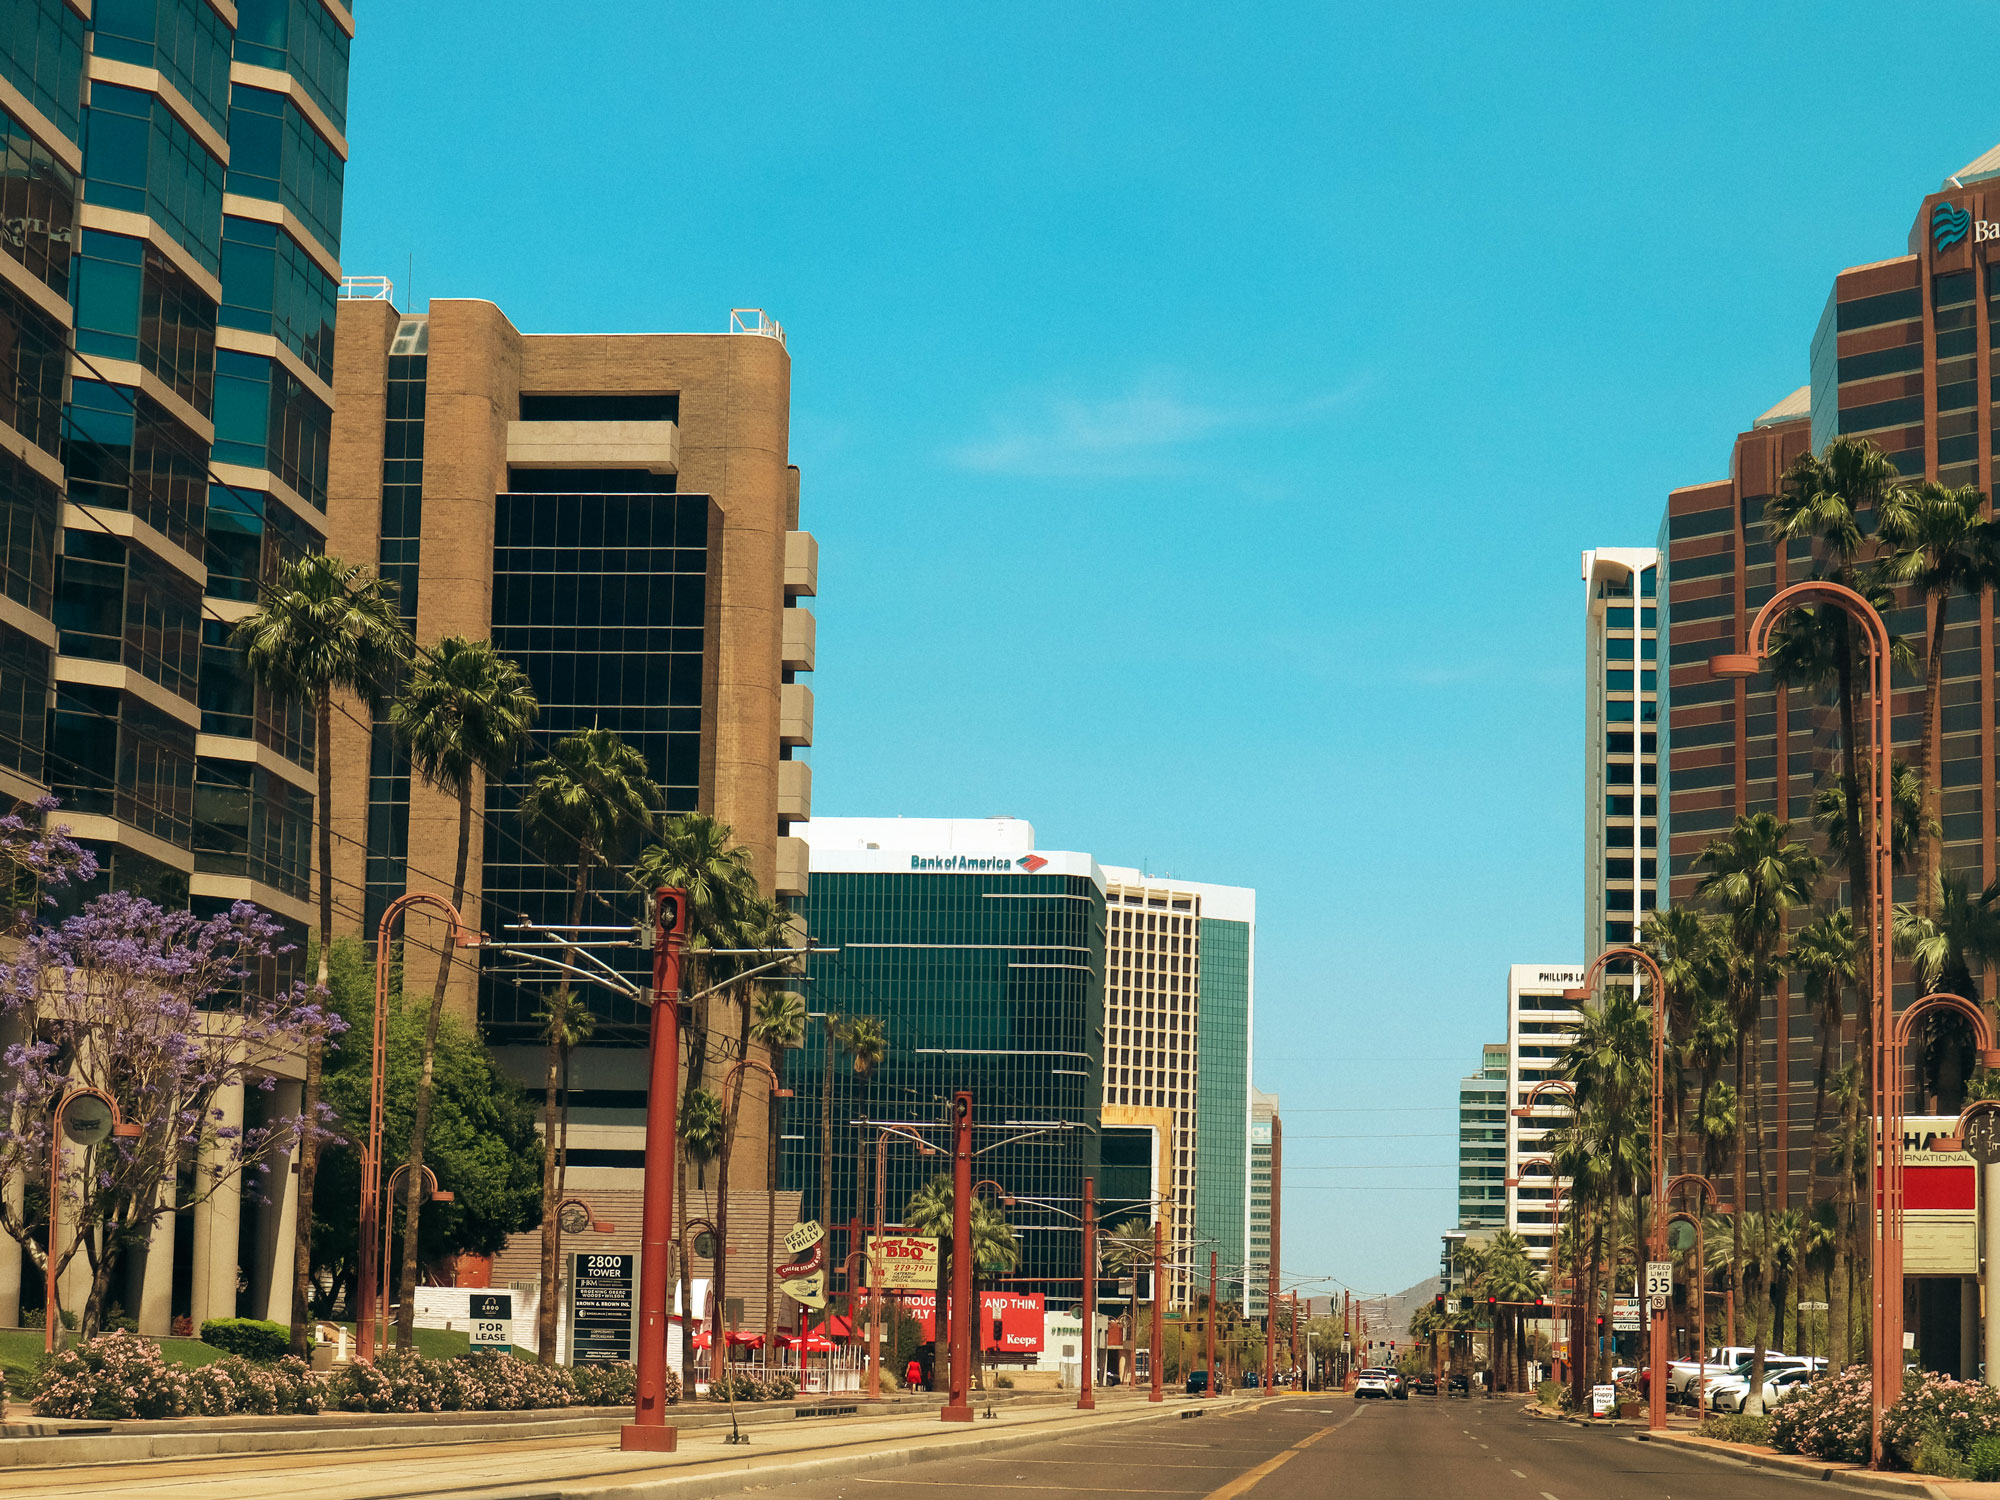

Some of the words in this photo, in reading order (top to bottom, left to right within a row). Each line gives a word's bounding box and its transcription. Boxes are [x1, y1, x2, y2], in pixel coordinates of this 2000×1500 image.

[911, 855, 943, 870] Bank
[944, 854, 957, 870] of
[958, 855, 1011, 871] America
[1539, 973, 1573, 982] PHILLIPS
[785, 1229, 806, 1245] BEST
[807, 1222, 817, 1233] OF
[791, 1230, 819, 1250] PHILLY
[886, 1247, 923, 1261] BBQ
[588, 1255, 622, 1268] 2800
[894, 1264, 933, 1272] 279-7911
[588, 1269, 621, 1277] TOWER
[1648, 1278, 1670, 1292] 35
[984, 1298, 1008, 1308] AND
[1010, 1299, 1040, 1310] THIN.
[478, 1322, 503, 1331] FOR
[475, 1333, 506, 1341] LEASE
[1006, 1334, 1037, 1347] Keeps
